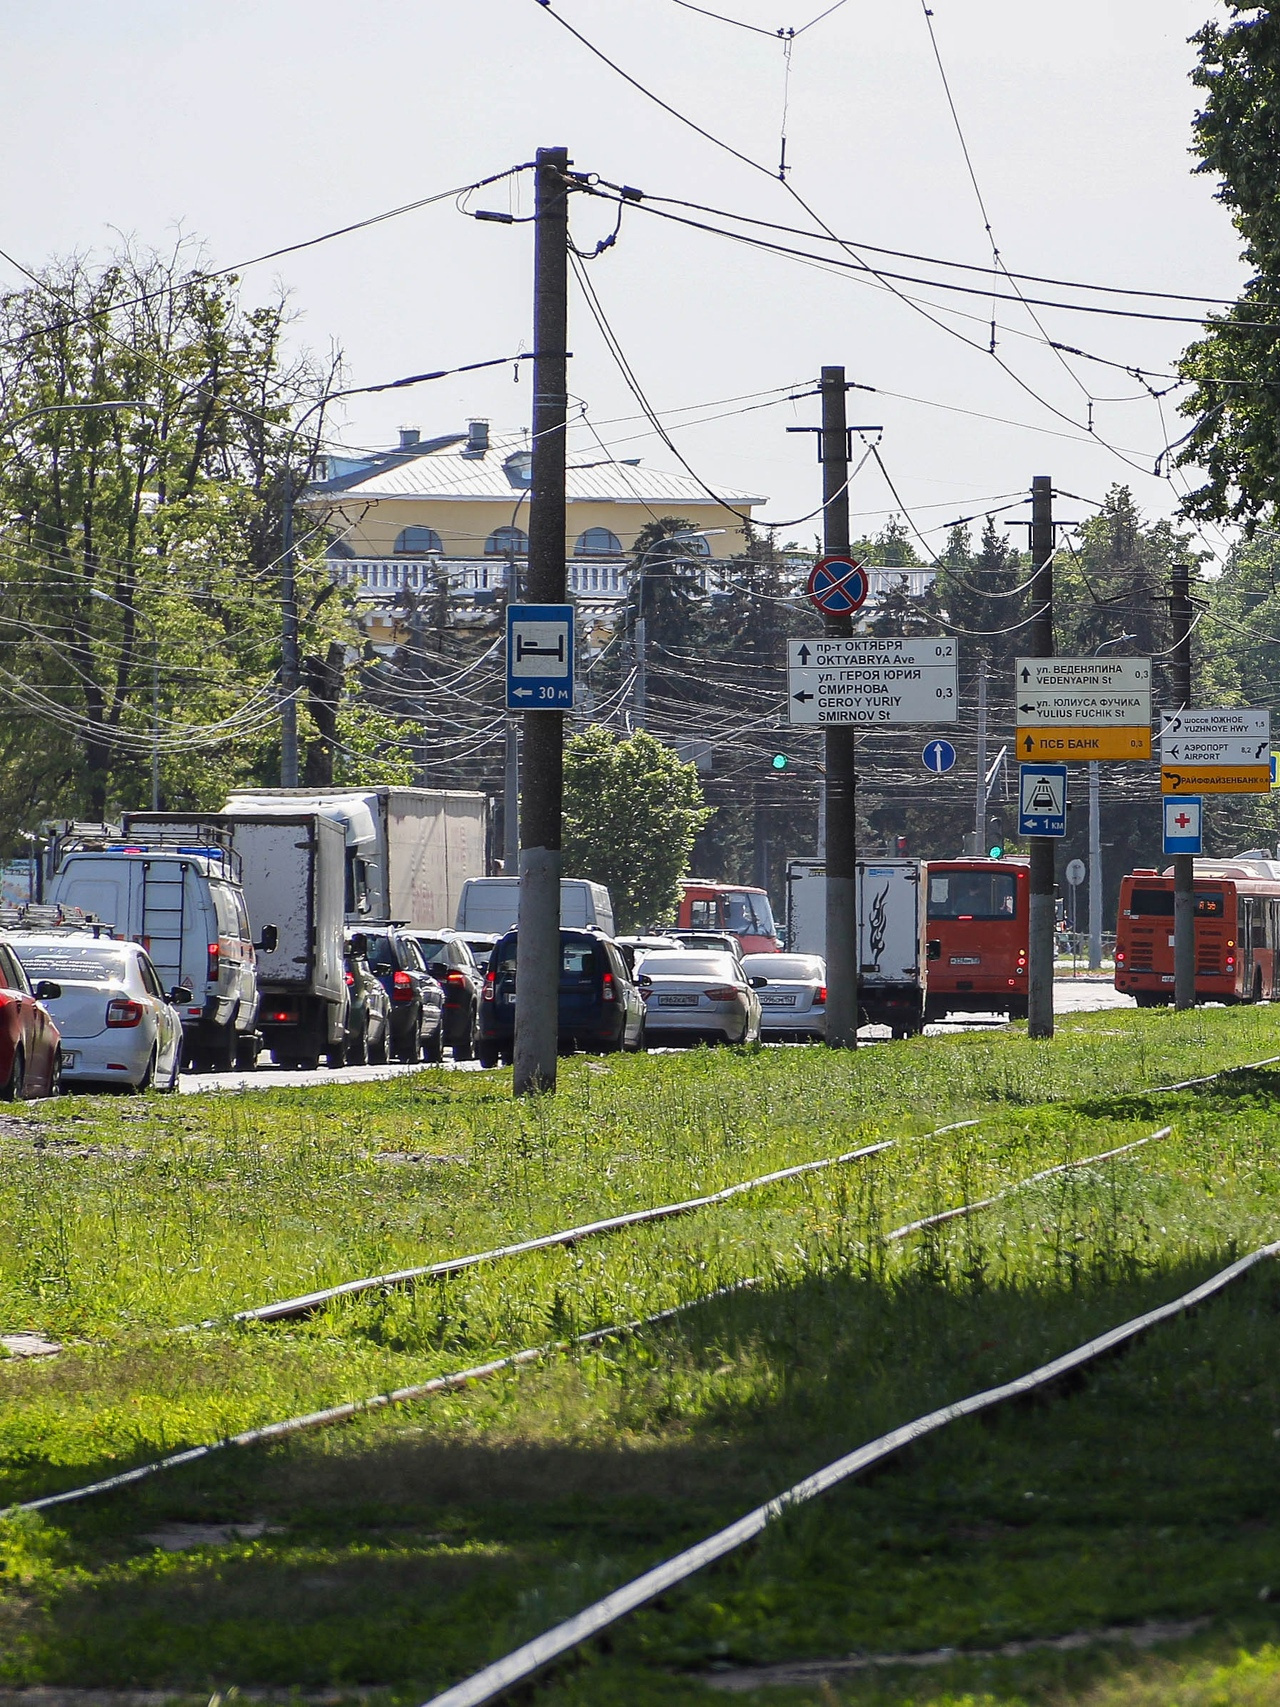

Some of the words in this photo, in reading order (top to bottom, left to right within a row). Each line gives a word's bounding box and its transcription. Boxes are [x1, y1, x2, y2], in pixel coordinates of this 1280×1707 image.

[817, 643, 841, 652] пр-т
[845, 641, 902, 651] ОКТЯБРЯ
[935, 646, 952, 657] 0,2
[817, 655, 893, 665] OKTYABRYA
[894, 655, 914, 664] Ave
[1036, 667, 1051, 675] ул.
[1054, 665, 1122, 675] ВЕДЕНЯПИНА
[818, 673, 835, 683] ул.
[840, 671, 880, 680] ГЕРОЯ
[884, 670, 921, 680] ЮРИЯ
[1135, 671, 1149, 680] 0,3
[539, 686, 554, 699] 30
[558, 690, 568, 699] м
[818, 684, 888, 694] СМИРНОВА
[936, 688, 952, 699] 0,3
[818, 698, 862, 707] GEROY
[865, 697, 901, 706] YURIY
[818, 711, 875, 721] SMIRNOV
[878, 711, 890, 720] St
[1040, 740, 1064, 748] ПСБ
[1068, 739, 1099, 748] БАНК
[1130, 740, 1143, 748] 0,3
[1044, 819, 1049, 829] 1
